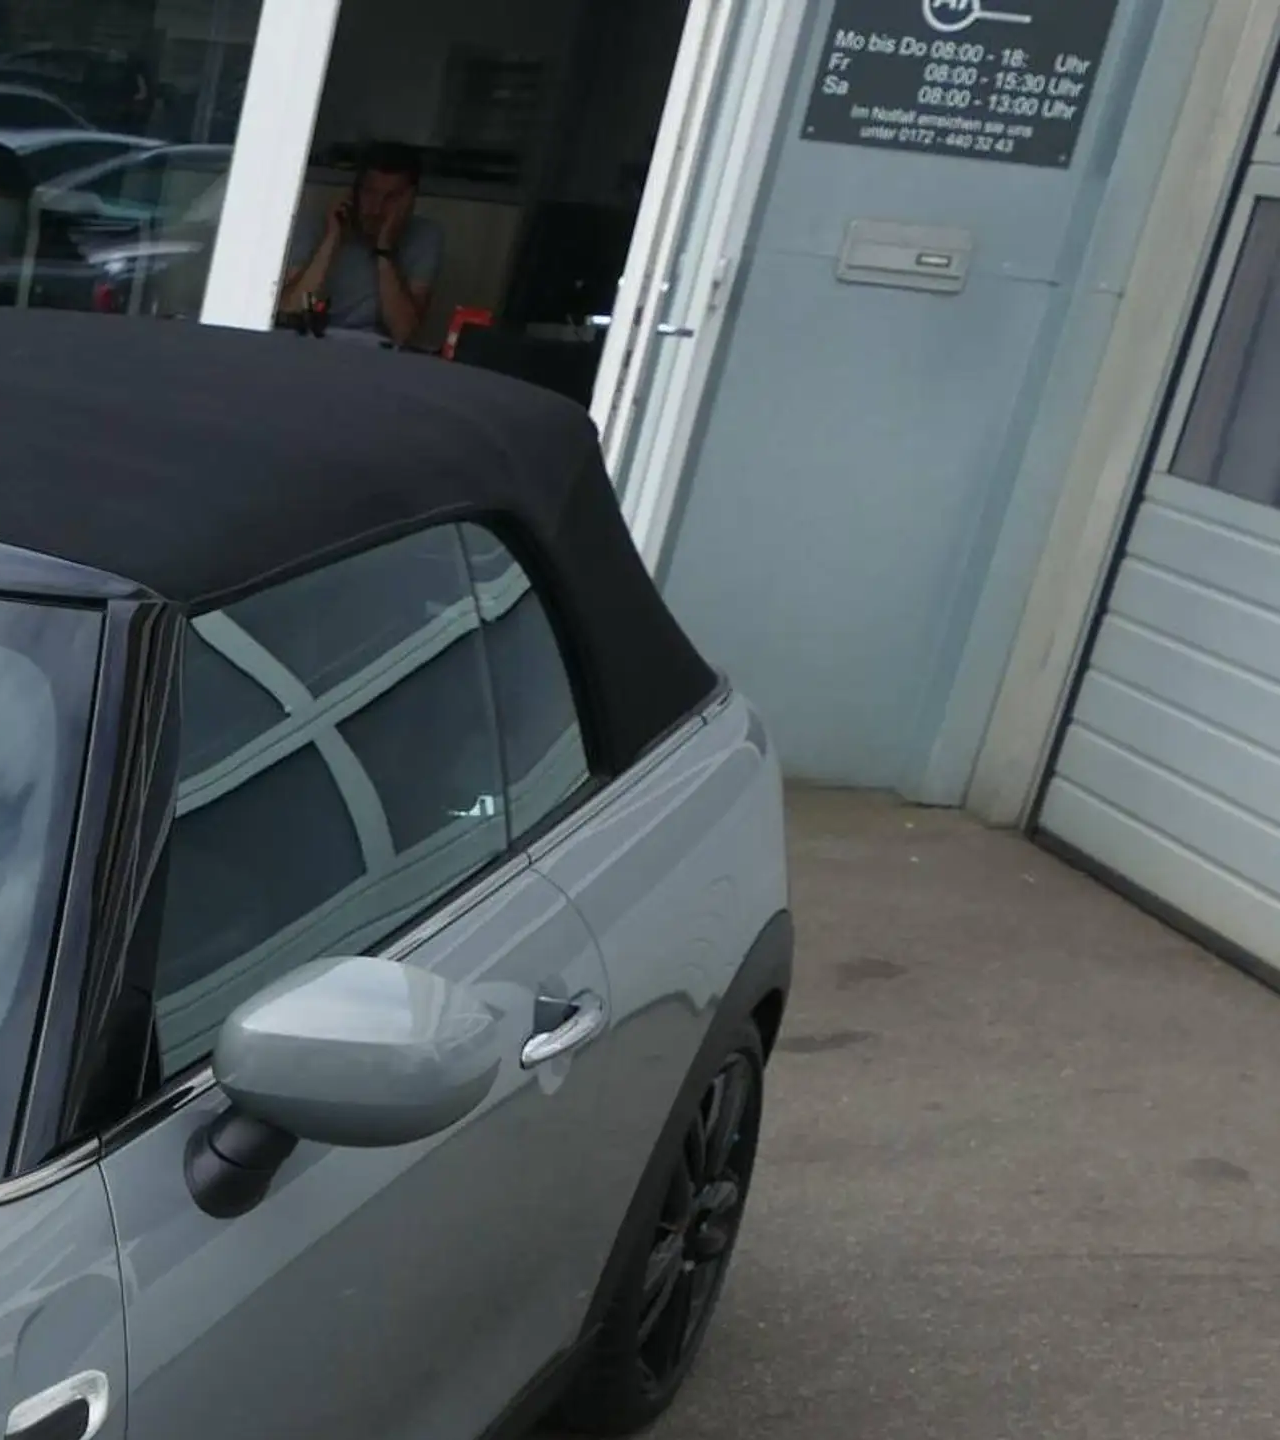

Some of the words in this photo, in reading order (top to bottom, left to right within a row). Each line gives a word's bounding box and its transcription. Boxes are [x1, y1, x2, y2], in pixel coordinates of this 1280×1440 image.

[828, 52, 852, 71] Fr
[924, 62, 978, 86] 08:00
[1047, 76, 1085, 97] Uhr
[835, 28, 865, 51] Mo
[868, 32, 896, 54] bis
[898, 36, 928, 57] Do
[930, 40, 984, 63] 08:00
[1054, 52, 1091, 75] Uhr
[822, 74, 850, 95] Sa
[917, 85, 971, 109] 08:00
[988, 93, 1039, 117] 13:00
[1041, 99, 1078, 120] Uhr
